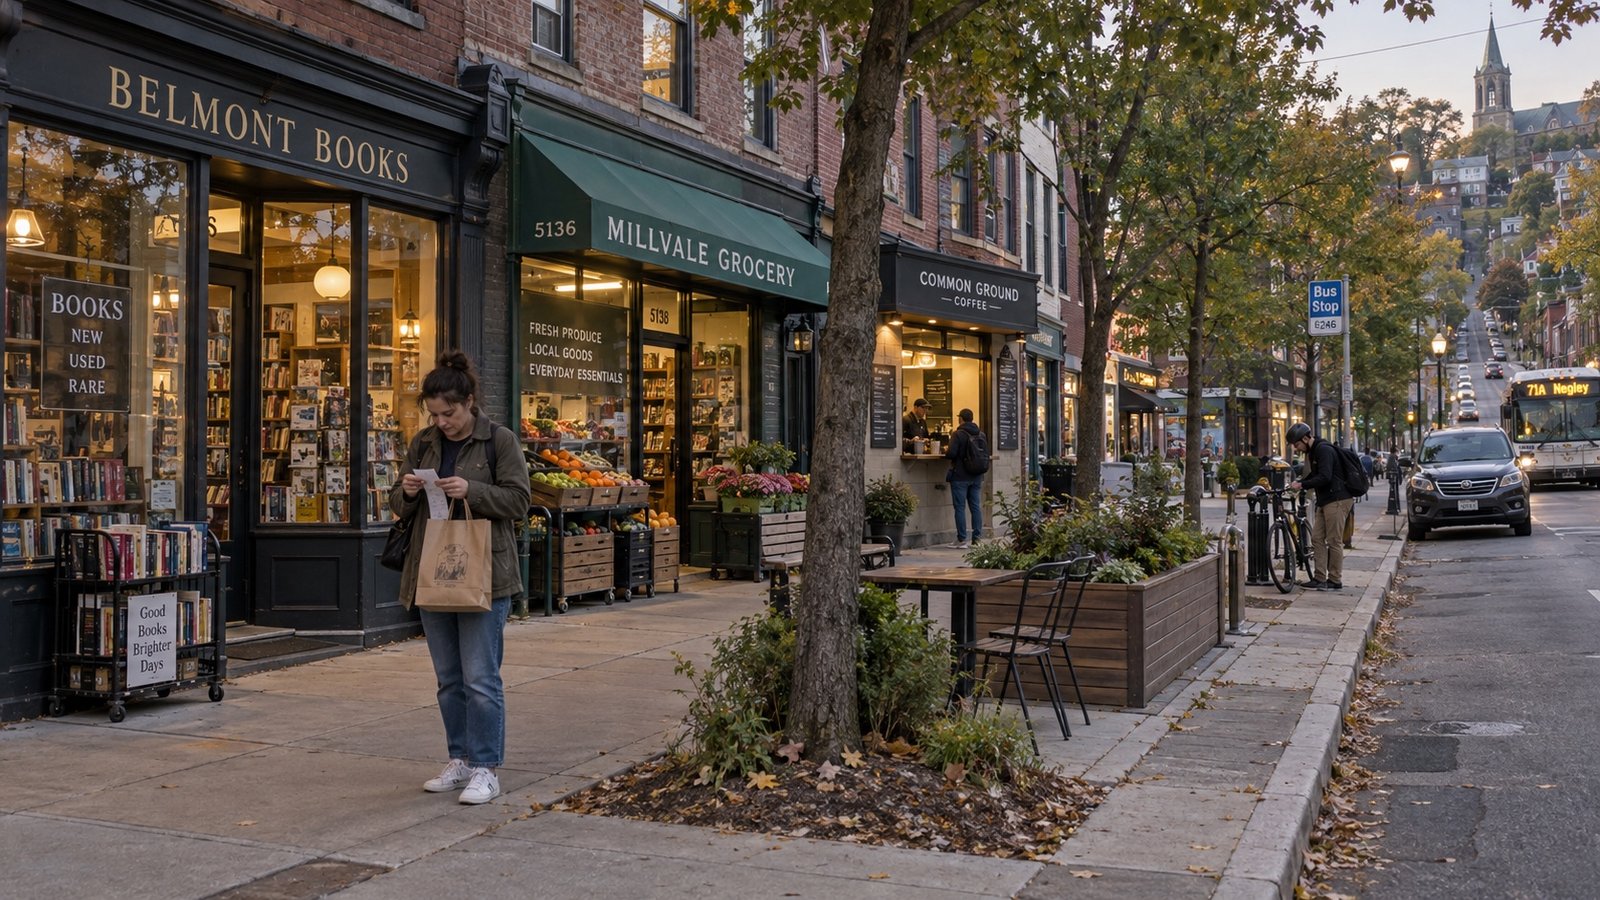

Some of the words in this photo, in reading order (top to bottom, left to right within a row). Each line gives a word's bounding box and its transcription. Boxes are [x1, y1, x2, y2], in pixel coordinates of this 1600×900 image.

[109, 66, 295, 153] BELMONT
[315, 128, 408, 183] BOOKS
[535, 220, 576, 238] 5136
[608, 216, 708, 265] MILLVALE
[718, 248, 795, 287] GROCERY
[920, 271, 971, 293] COMMON
[976, 282, 1019, 301] GROUND
[1314, 286, 1337, 297] Bus
[51, 292, 123, 320] BOOKS
[954, 296, 987, 310] COFFEE
[1312, 301, 1339, 314] Stop
[650, 307, 669, 325] 5138
[72, 328, 103, 344] NEW
[529, 321, 559, 338] FRESH
[562, 328, 602, 344] PRODUCE
[529, 343, 560, 358] LOCAL
[563, 348, 593, 362] GOODS
[69, 354, 106, 369] USED
[529, 363, 575, 380] EVERYDAY
[577, 369, 623, 384] ESSENTIALS
[69, 379, 105, 394] RARE
[1527, 384, 1546, 396] 71A
[1553, 382, 1589, 396] Negley
[140, 604, 166, 619] Good
[138, 623, 167, 638] Books
[133, 641, 172, 657] Brighter
[140, 660, 164, 673] Days
